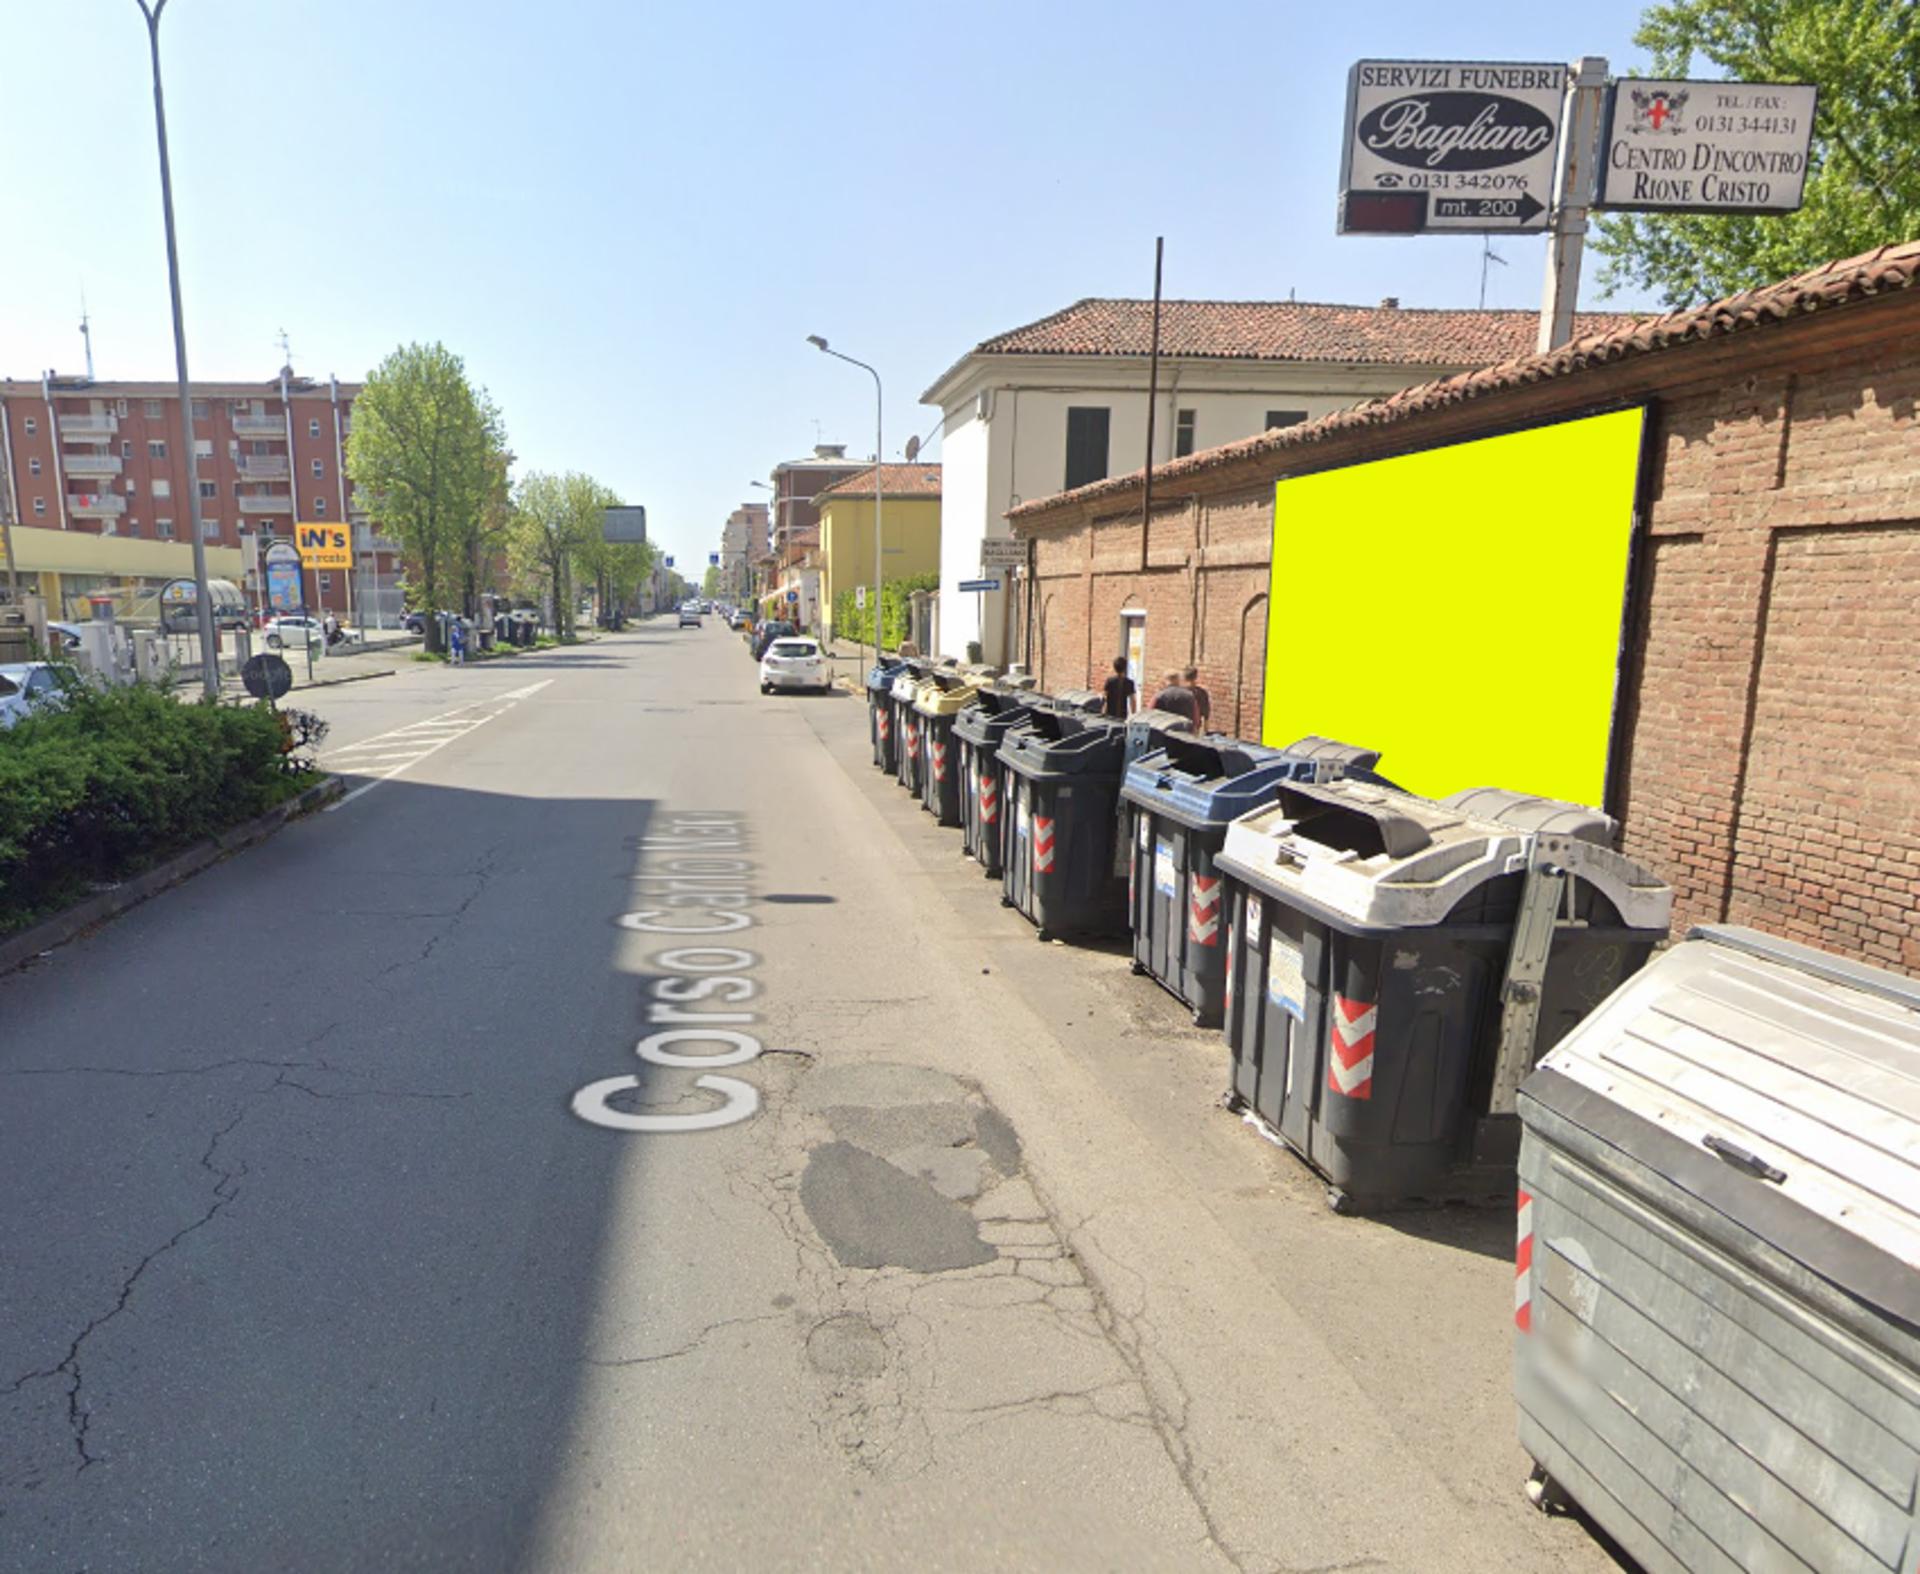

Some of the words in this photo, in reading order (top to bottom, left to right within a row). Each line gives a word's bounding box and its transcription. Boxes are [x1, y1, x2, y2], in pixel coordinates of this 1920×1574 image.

[1361, 66, 1450, 87] SERVIZI
[1458, 68, 1560, 90] FUNEBRI
[1367, 100, 1550, 166] Bagliano
[1695, 114, 1733, 132] 0131
[1736, 116, 1798, 135] 344131
[1611, 139, 1687, 171] CENTRO
[1692, 143, 1804, 175] D'INCONTRO
[1408, 174, 1450, 189] 0131
[1454, 174, 1529, 190] 342076
[1632, 170, 1694, 201] RIONE
[1701, 172, 1771, 203] CRISTO
[1440, 201, 1473, 216] mt.
[1479, 200, 1518, 216] 200
